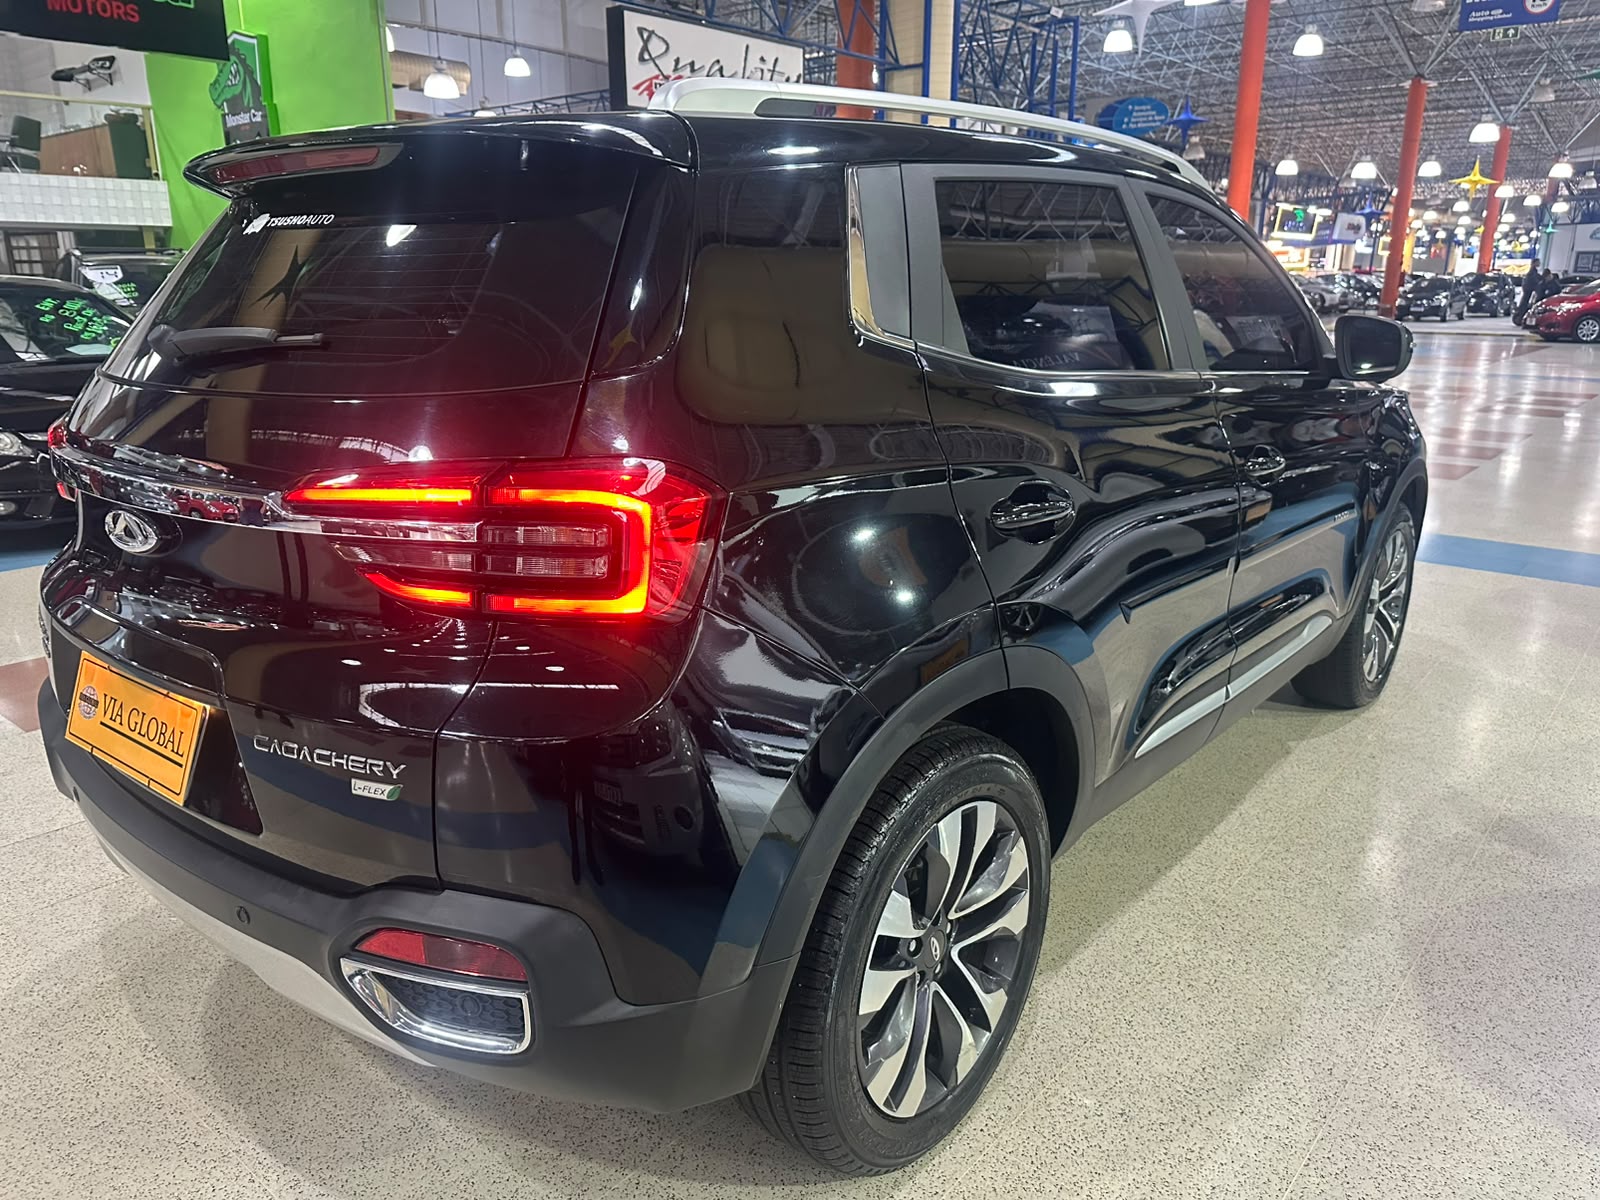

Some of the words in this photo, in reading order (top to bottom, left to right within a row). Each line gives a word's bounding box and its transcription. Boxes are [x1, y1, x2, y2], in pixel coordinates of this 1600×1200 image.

[47, 0, 140, 23] MOTORS
[225, 111, 250, 128] Monster
[251, 109, 262, 122] Car
[267, 214, 335, 227] TSUSHOAUTO
[102, 693, 123, 726] VIA
[127, 707, 184, 757] GLOBAL
[253, 734, 406, 779] CAOACHERY
